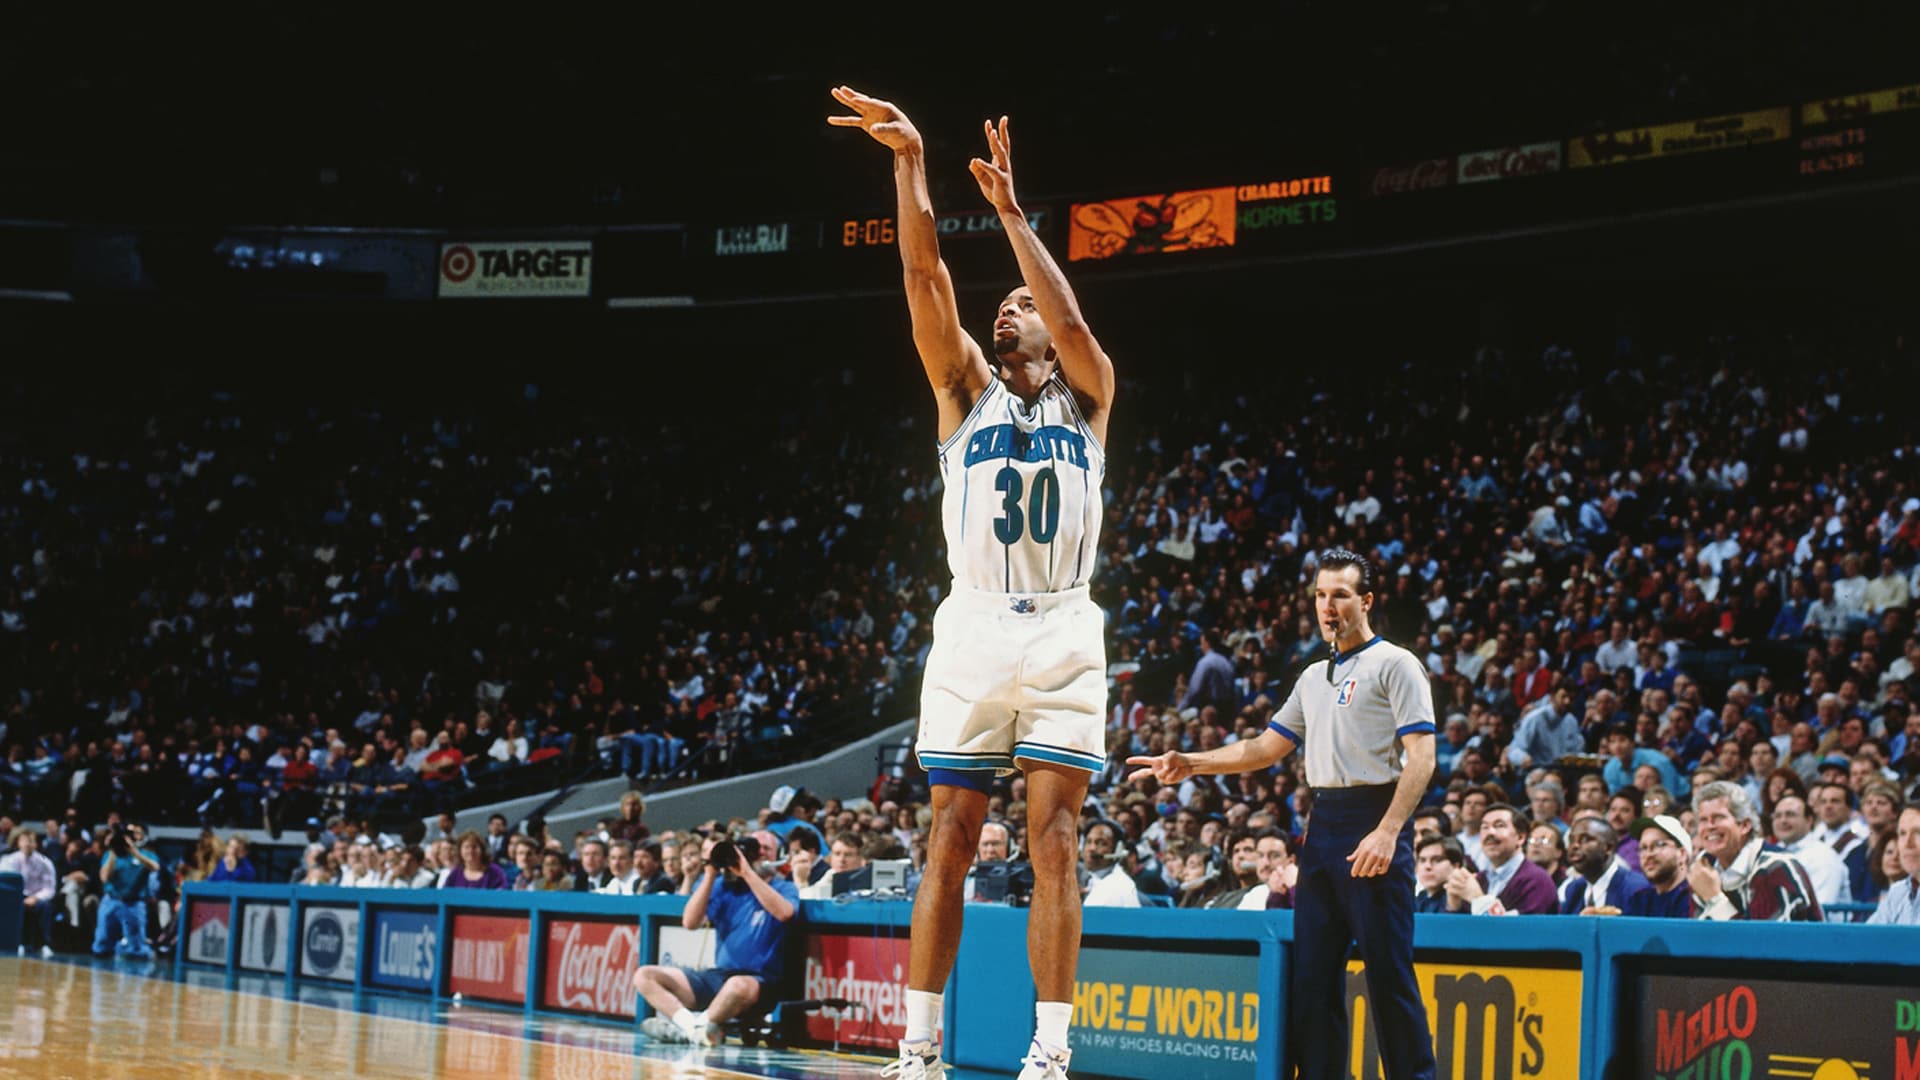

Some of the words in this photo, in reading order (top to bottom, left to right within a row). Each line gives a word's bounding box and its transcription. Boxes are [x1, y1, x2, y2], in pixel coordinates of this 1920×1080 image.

[1237, 176, 1332, 202] CHARLOTTE
[965, 210, 1046, 233] LIGT
[1237, 199, 1337, 231] HORNETS
[842, 218, 897, 247] 8:06
[478, 250, 592, 278] TARGET
[993, 467, 1060, 545] 30
[805, 957, 908, 1028] Budweis
[1655, 985, 1758, 1073] MELLO
[1094, 1034, 1116, 1048] PAY
[1119, 1036, 1162, 1053] SHOES
[1165, 1041, 1221, 1060] RACING
[1655, 1039, 1753, 1080] LLO
